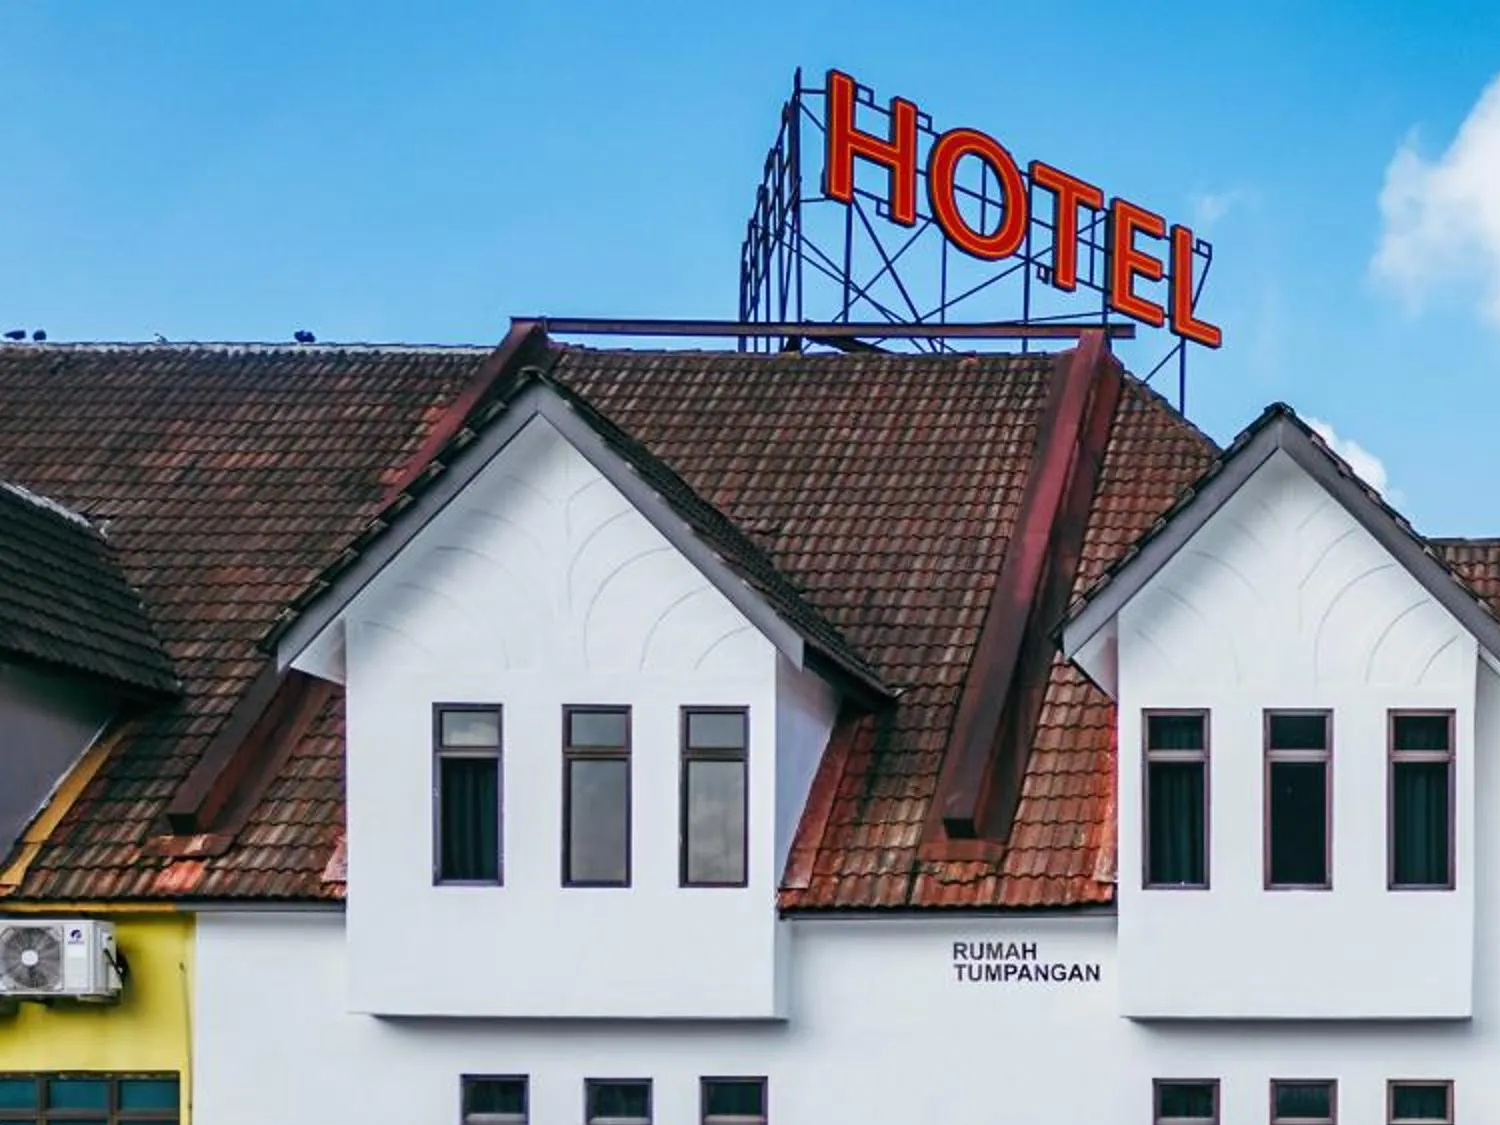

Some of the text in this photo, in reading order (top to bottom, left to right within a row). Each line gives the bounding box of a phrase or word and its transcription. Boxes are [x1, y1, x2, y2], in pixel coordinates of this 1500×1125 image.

[822, 68, 1222, 349] HOTEL
[953, 942, 1037, 960] RUMAH
[954, 964, 1101, 982] TUMPANGAN
